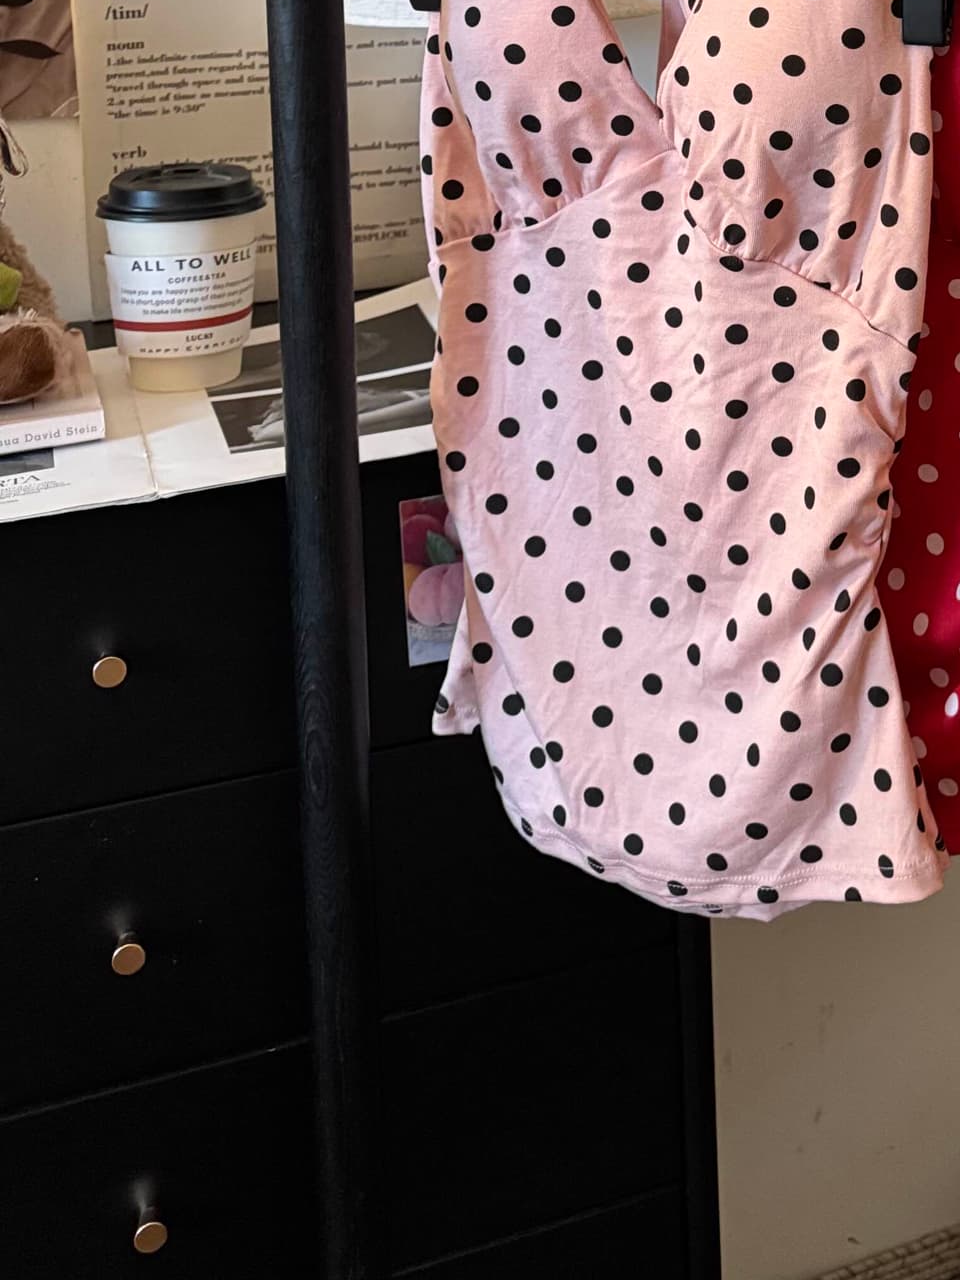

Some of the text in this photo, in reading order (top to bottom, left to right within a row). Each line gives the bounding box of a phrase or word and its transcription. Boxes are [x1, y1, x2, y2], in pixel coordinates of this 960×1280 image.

[104, 3, 149, 21] /tim/
[106, 41, 145, 52] noun
[137, 53, 188, 65] indefinite
[190, 49, 242, 60] continued
[172, 65, 205, 75] future
[208, 61, 255, 73] regarded
[147, 78, 189, 90] through
[224, 75, 244, 84] and
[129, 94, 156, 107] point
[159, 92, 172, 102] of
[173, 91, 196, 101] time
[214, 87, 265, 99] measured
[134, 107, 158, 117] time
[112, 146, 147, 160] verb
[131, 249, 251, 272] ALL TO WELL
[168, 272, 226, 285] COFFEE&TEA
[165, 287, 188, 297] happy
[177, 296, 199, 306] grasp
[24, 428, 60, 443] David
[66, 425, 98, 436] Stein
